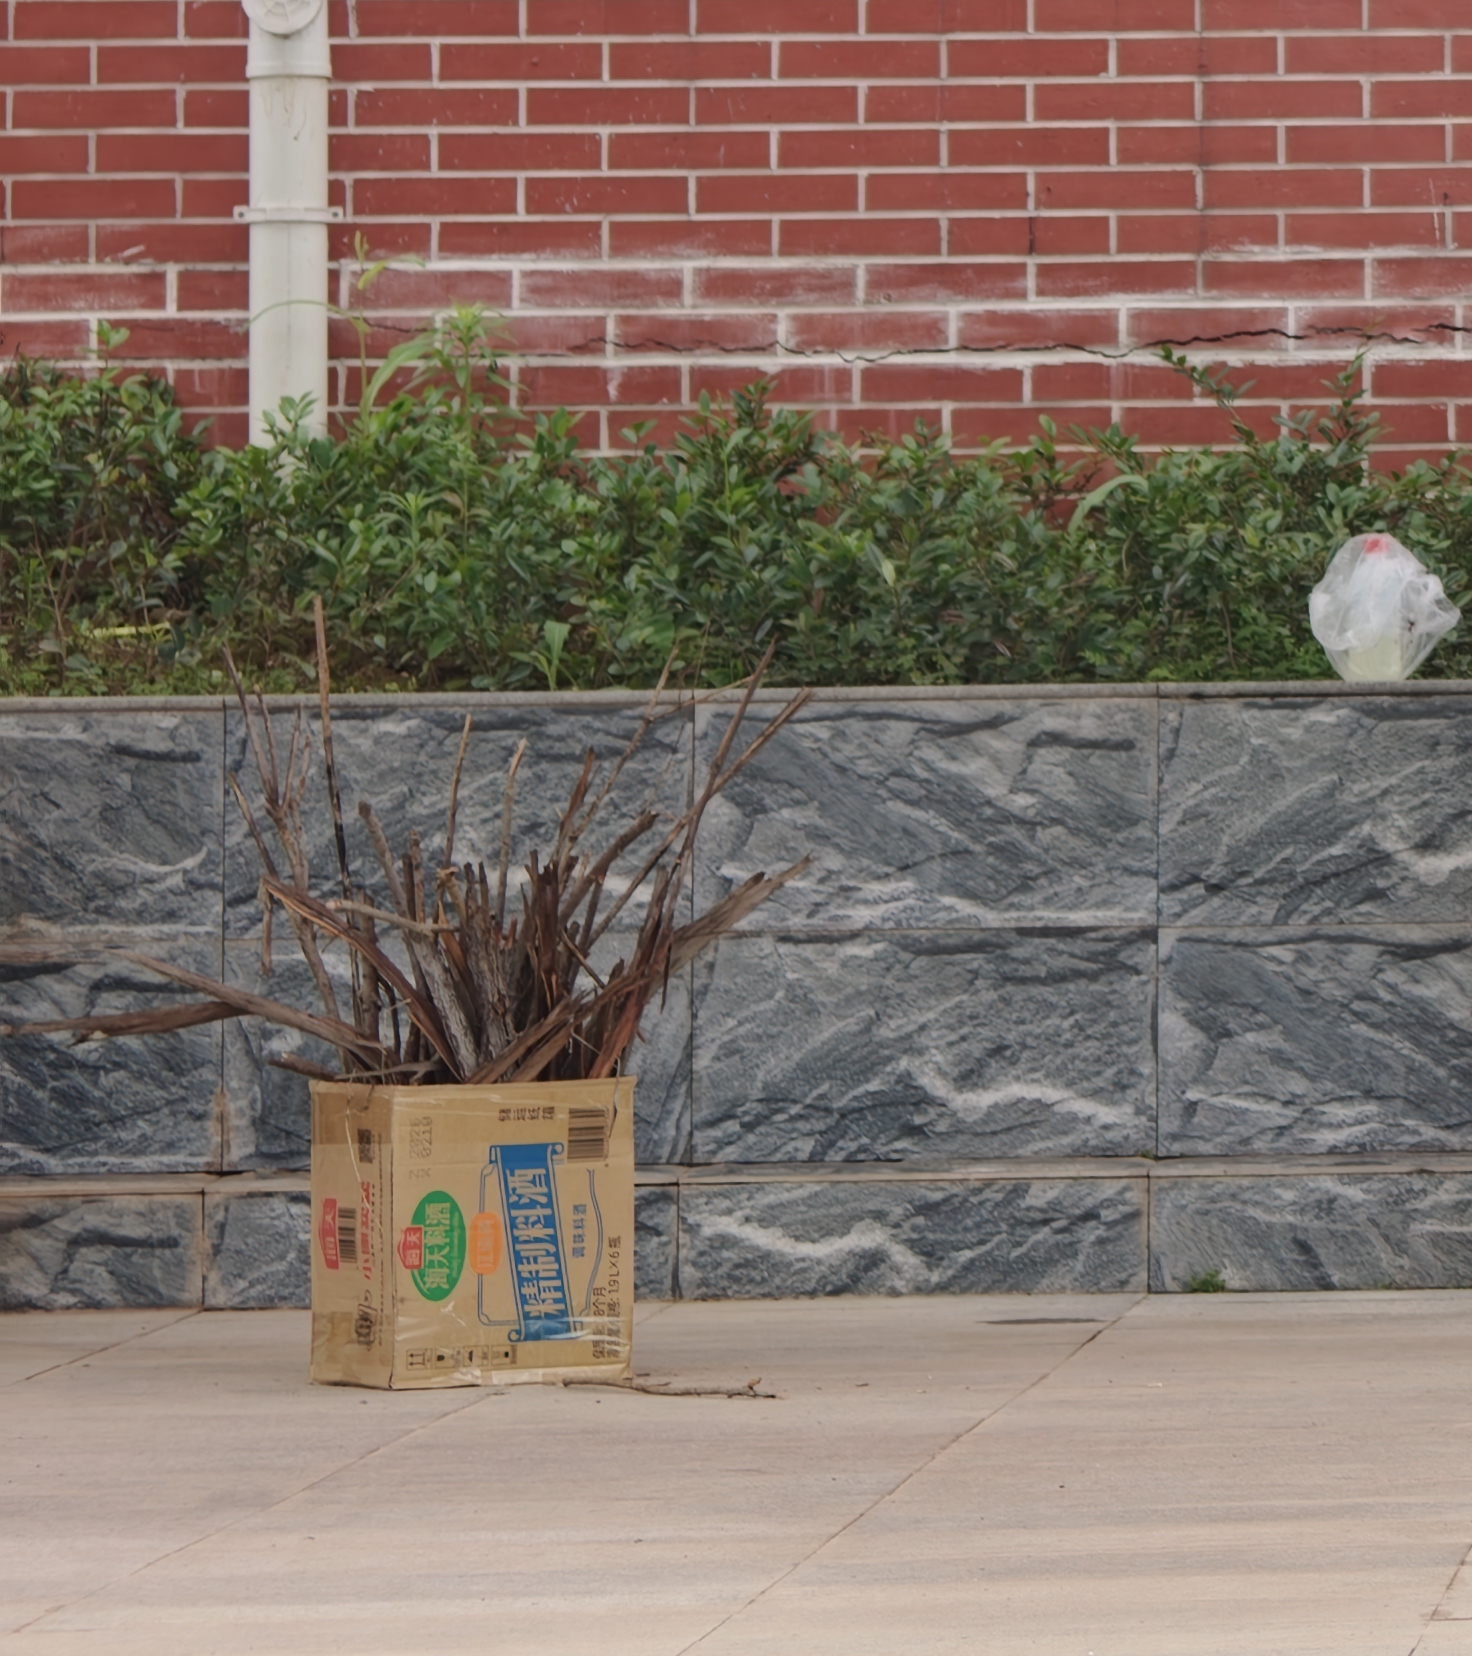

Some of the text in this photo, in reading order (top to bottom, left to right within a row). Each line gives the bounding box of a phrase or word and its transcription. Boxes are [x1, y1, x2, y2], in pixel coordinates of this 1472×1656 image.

[424, 1202, 451, 1290] 海天料酒
[507, 1167, 566, 1317] 精制料酒
